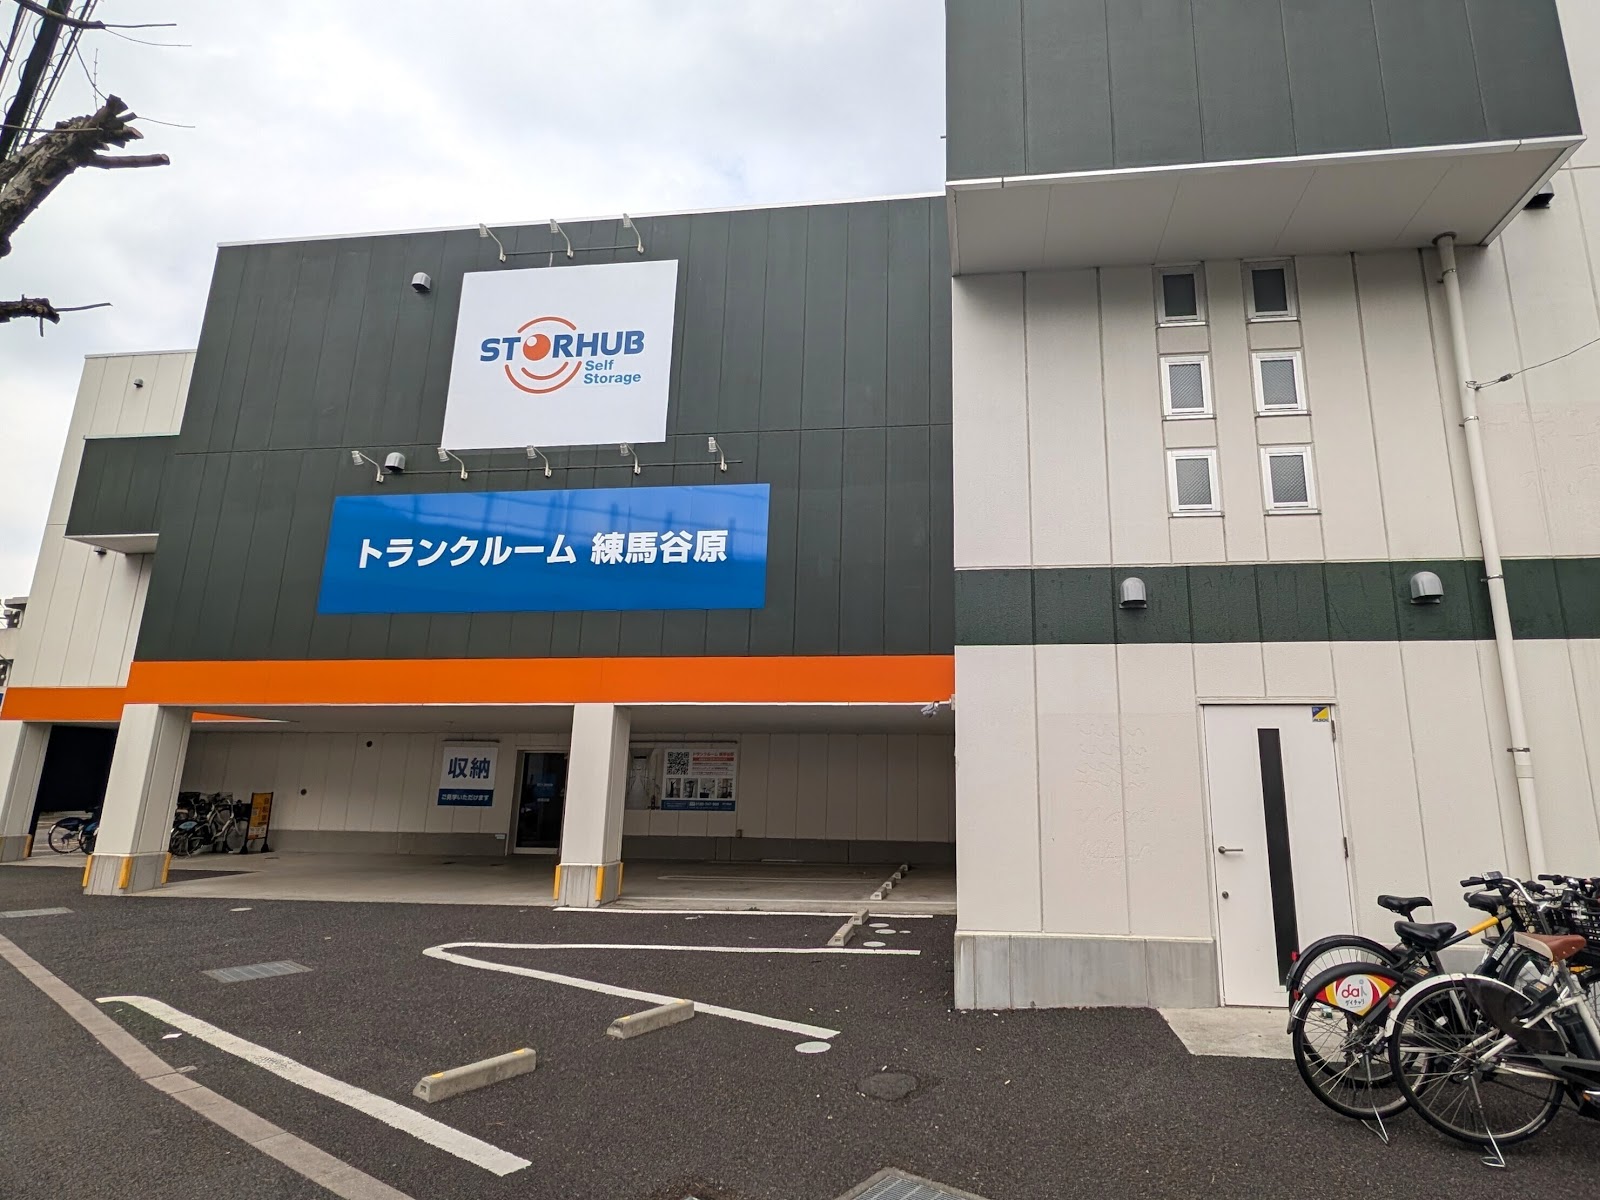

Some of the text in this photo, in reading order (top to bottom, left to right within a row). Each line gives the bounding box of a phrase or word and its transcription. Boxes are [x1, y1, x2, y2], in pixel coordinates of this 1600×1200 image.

[584, 359, 614, 371] Self
[583, 372, 642, 385] Storage
[358, 529, 729, 569] トランクルーム 練馬谷原
[448, 757, 491, 779] 収納
